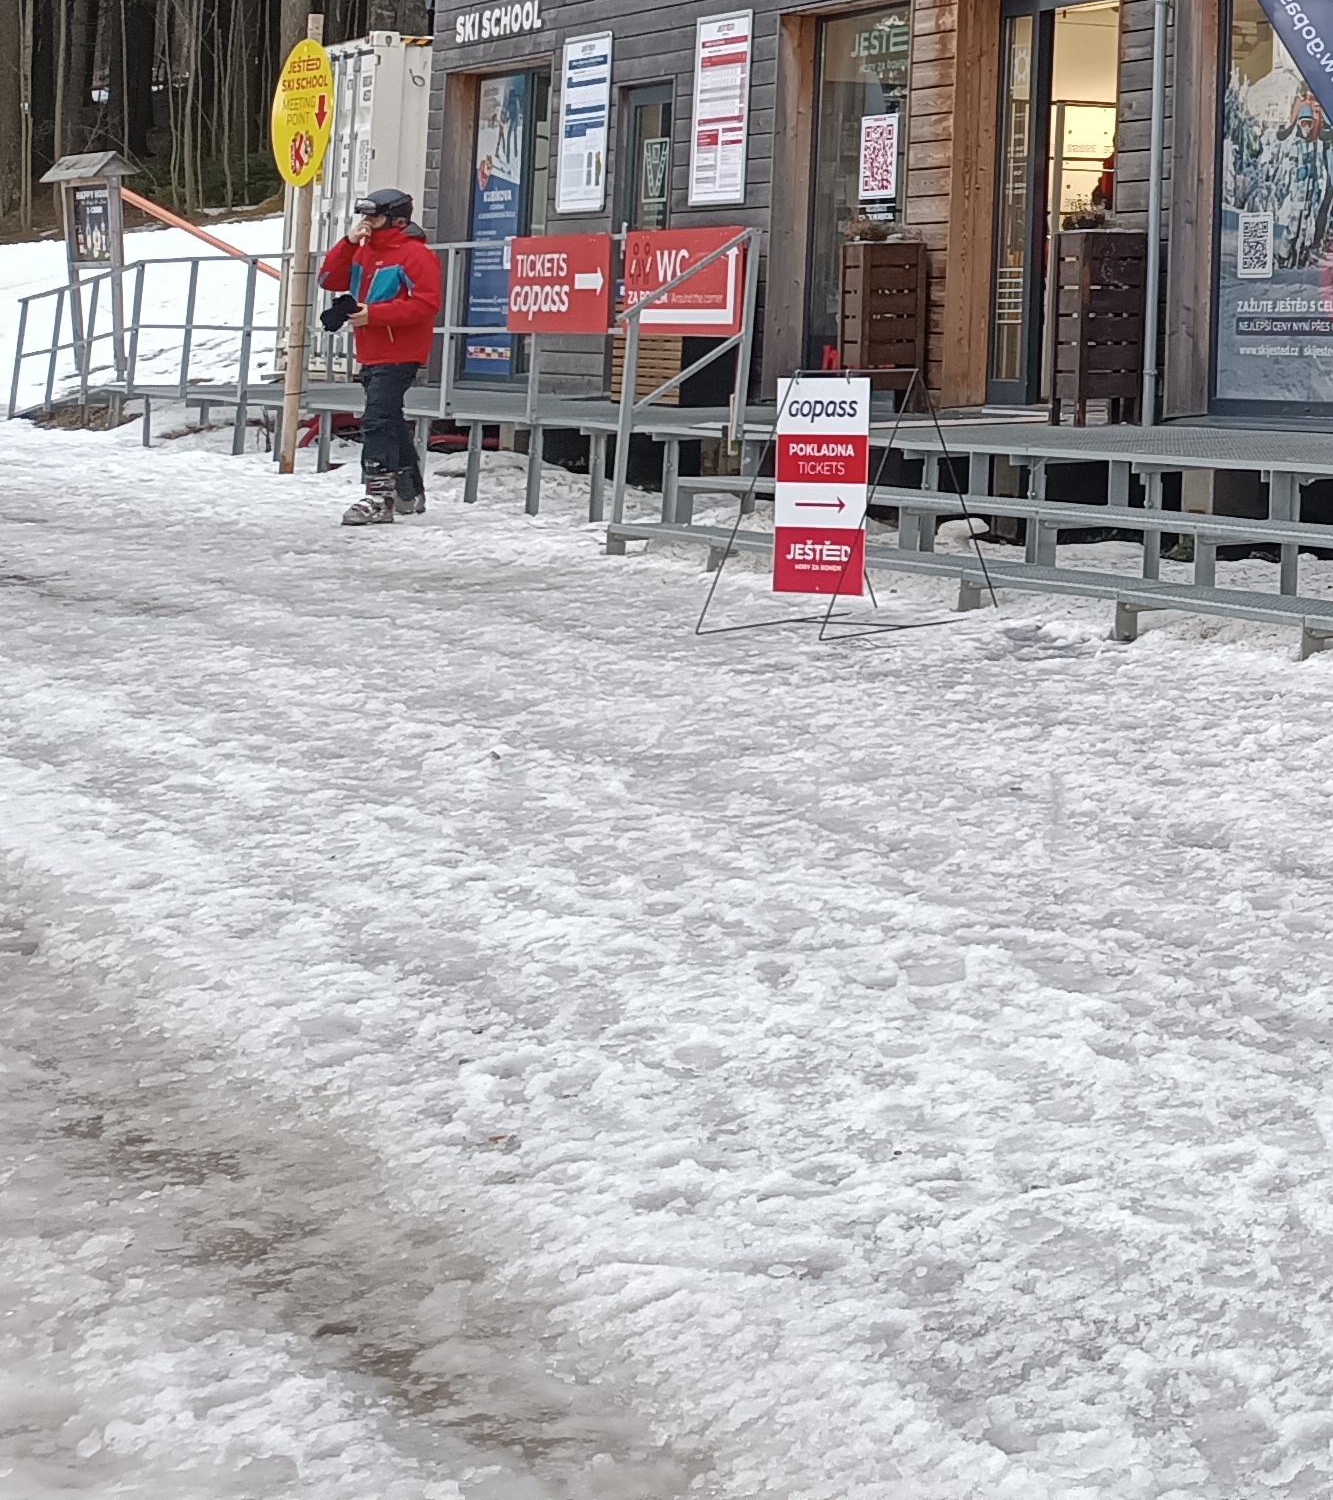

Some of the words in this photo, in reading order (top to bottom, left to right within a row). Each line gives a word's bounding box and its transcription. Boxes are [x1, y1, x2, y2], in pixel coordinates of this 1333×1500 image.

[456, 12, 480, 44] SKI
[481, 0, 542, 39] SCHOOL
[288, 55, 322, 74] JEŠTĚD
[282, 78, 295, 93] SKI
[296, 74, 329, 91] SCHOOL
[282, 95, 316, 112] MEETING
[286, 111, 310, 127] POINT
[516, 253, 567, 278] TICKETS
[656, 248, 690, 283] WC
[1237, 298, 1273, 313] ZAŽIJTE
[1274, 297, 1308, 313] JEŠTĚD
[1309, 301, 1316, 312] S
[1273, 321, 1292, 331] CENY
[1239, 344, 1299, 358] www.skijested.cz
[789, 443, 855, 457] POKLADNA
[798, 461, 845, 476] TICKETS
[786, 540, 851, 562] JEŠTĚD
